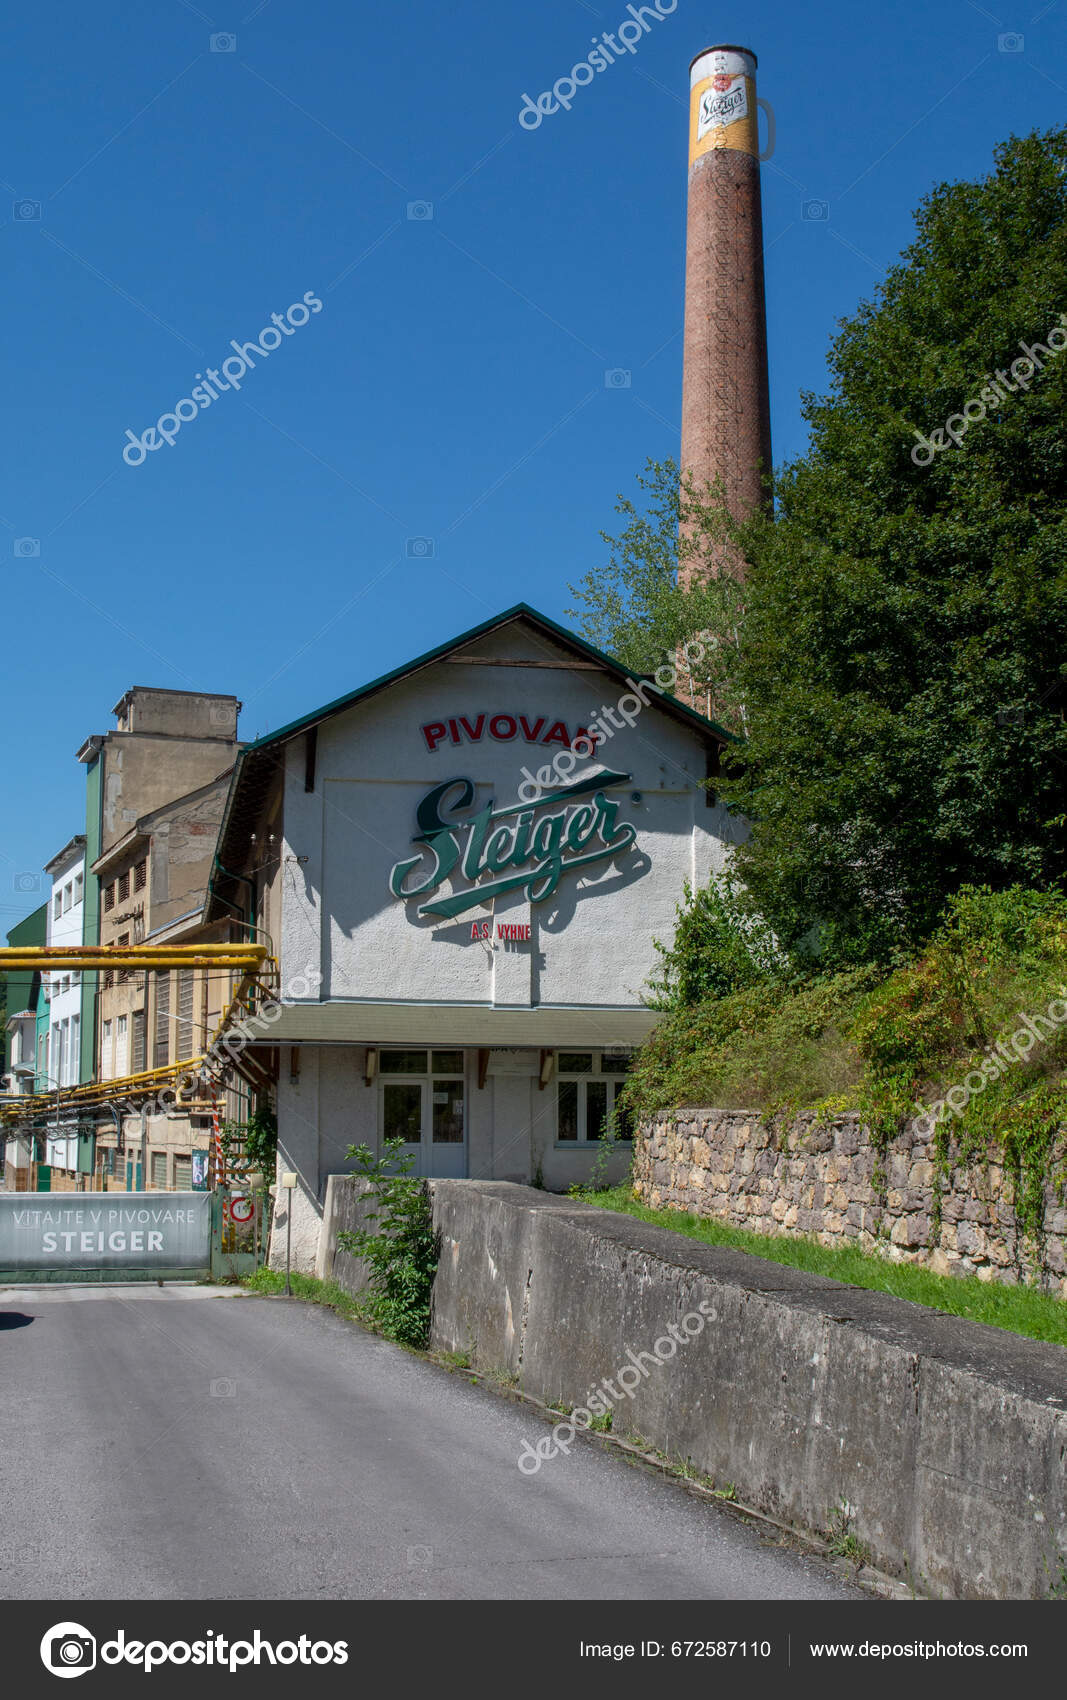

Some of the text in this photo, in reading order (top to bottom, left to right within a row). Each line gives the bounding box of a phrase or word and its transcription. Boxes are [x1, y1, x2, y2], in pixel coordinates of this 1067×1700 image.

[389, 770, 637, 917] Steiger
[497, 923, 531, 941] VYHNE
[13, 1209, 195, 1224] VITAJTE V PIVOVARE
[42, 1230, 164, 1253] STEIGER
